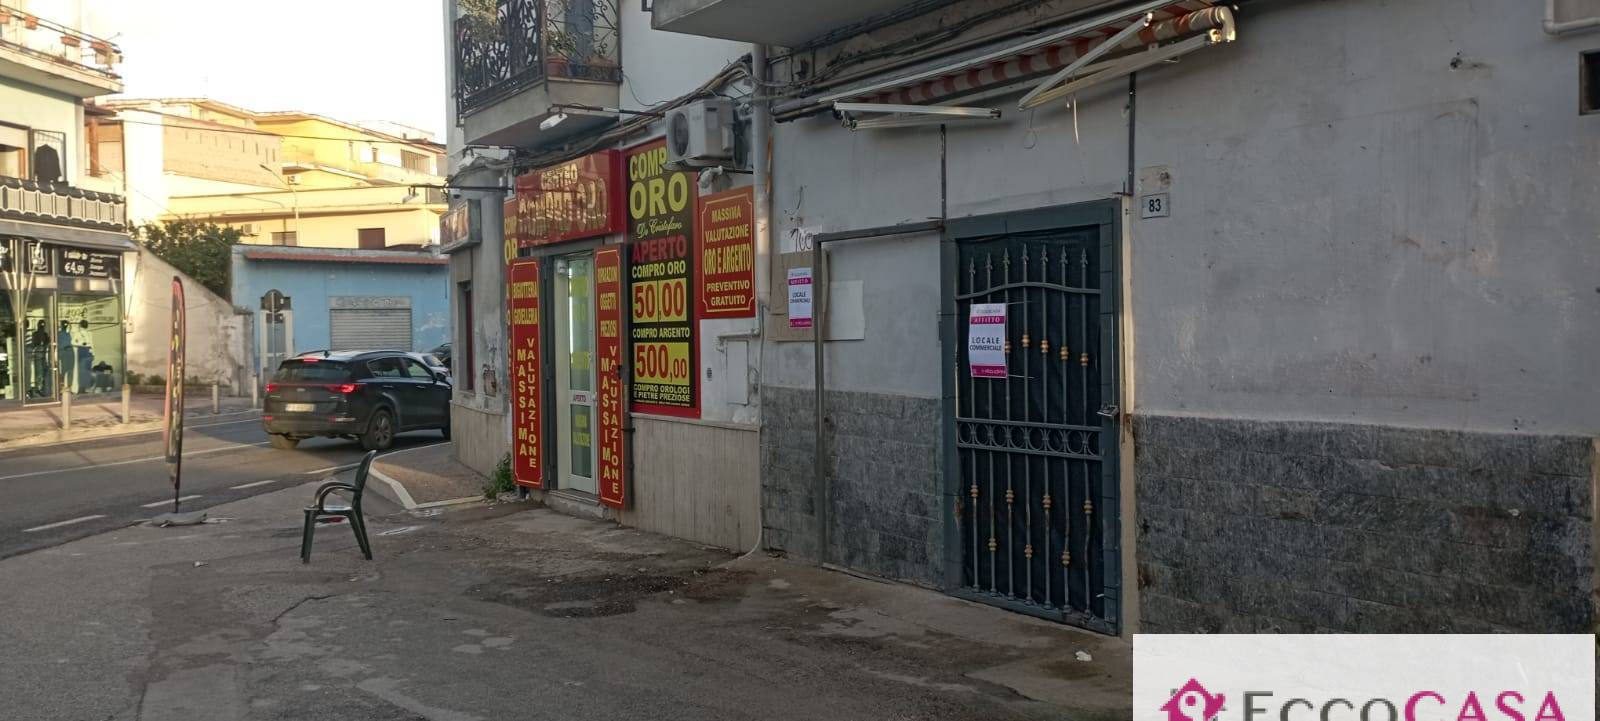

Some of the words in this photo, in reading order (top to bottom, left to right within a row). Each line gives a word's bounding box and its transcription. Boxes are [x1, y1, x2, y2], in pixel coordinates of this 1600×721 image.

[630, 147, 667, 181] COMP
[629, 171, 688, 220] ORO
[1148, 198, 1162, 213] 83
[711, 205, 741, 223] MASSIMA
[705, 223, 749, 243] VALUTAZIONE
[632, 235, 687, 263] APERTO
[632, 262, 665, 279] COMPRO
[667, 259, 686, 275] ORO
[704, 248, 716, 276] ORO
[717, 247, 722, 274] E
[723, 243, 752, 273] ARGENTO
[706, 280, 750, 292] PREVENTIVO
[710, 295, 746, 306] GRATUITO
[632, 328, 657, 338] COMPRO
[658, 327, 690, 338] ARGENTO
[971, 336, 1001, 344] LOCALE
[633, 383, 659, 393] COMPRO
[660, 385, 690, 395] OROLOGI
[660, 393, 690, 402] PREZIOSE
[517, 349, 528, 457] MASSIMA
[526, 337, 537, 468] VALUTAZIONE
[601, 357, 611, 479] MASSIMA
